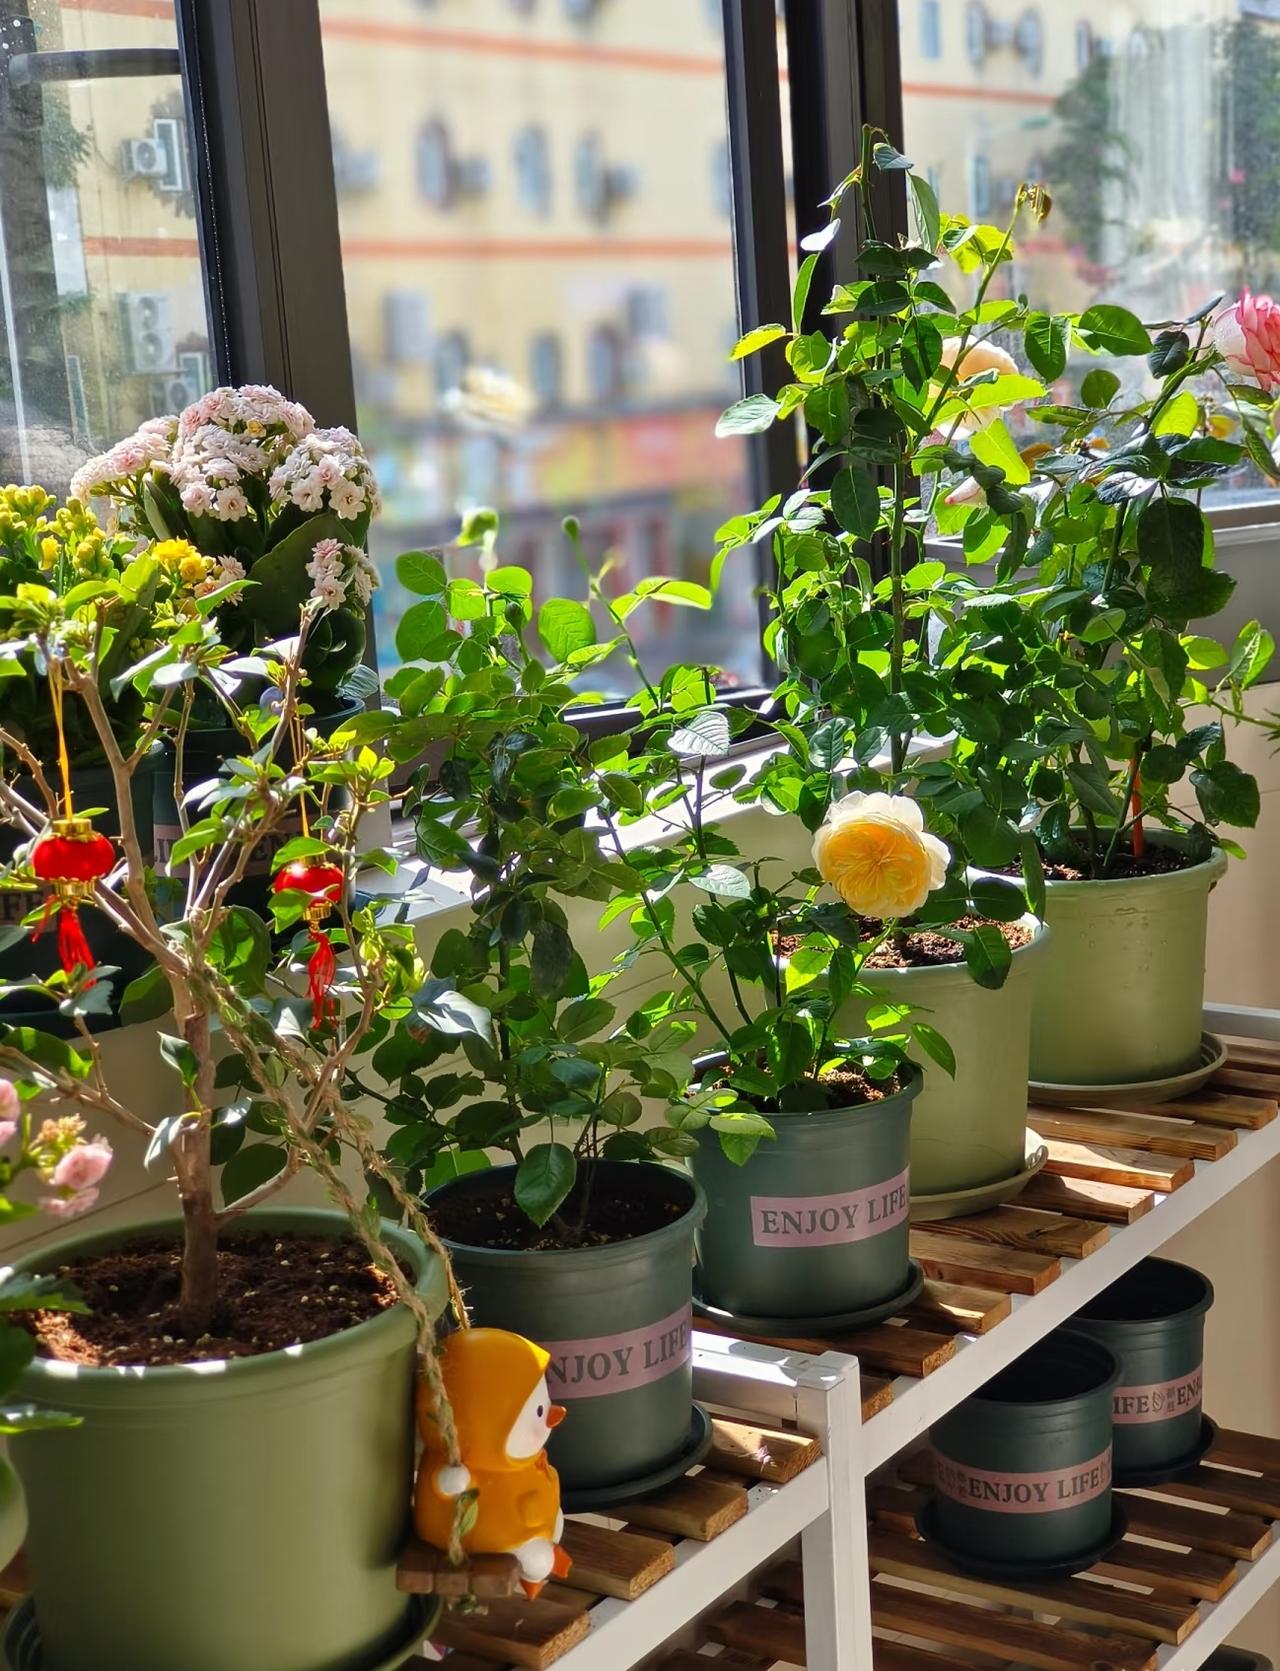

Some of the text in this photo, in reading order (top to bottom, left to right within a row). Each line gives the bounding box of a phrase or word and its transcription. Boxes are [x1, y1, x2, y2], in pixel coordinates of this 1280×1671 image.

[761, 1184, 907, 1235] ENJOY LIFE
[546, 1320, 687, 1384] NJOY LIFE
[1112, 1395, 1150, 1414] IFE
[967, 1476, 1049, 1503] ENJOY
[1057, 1466, 1099, 1500] LIFE
